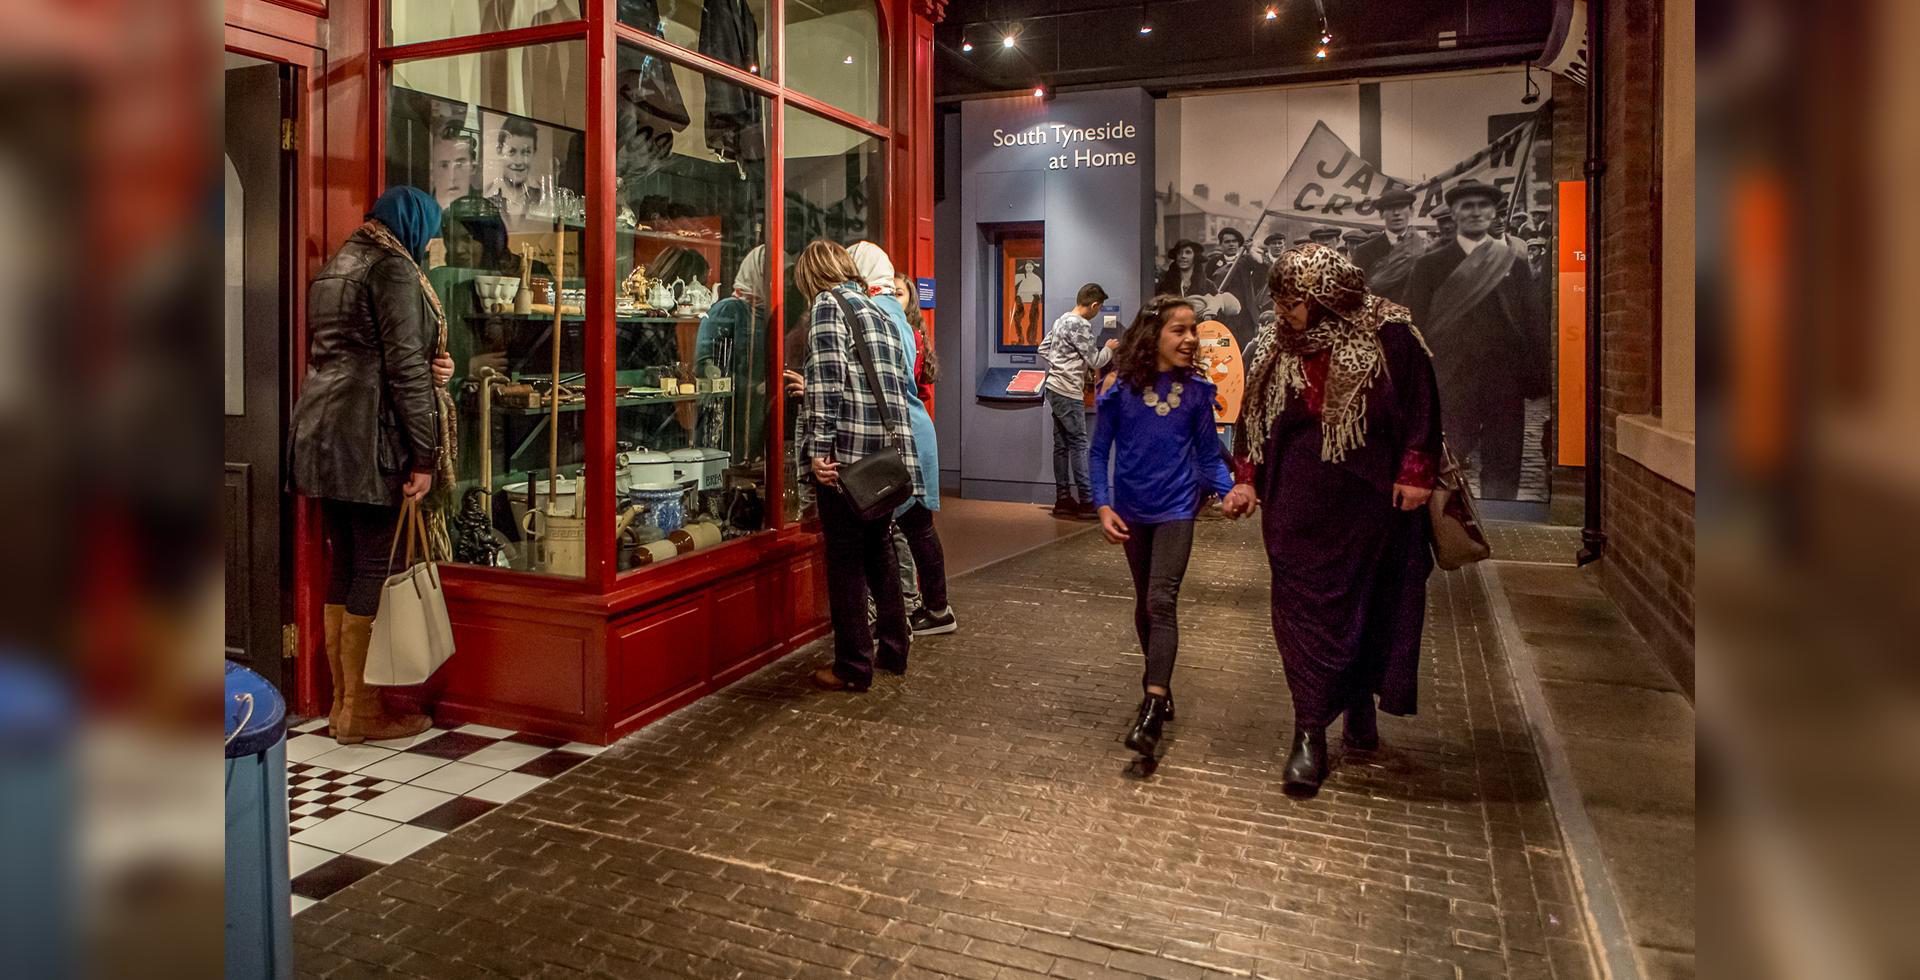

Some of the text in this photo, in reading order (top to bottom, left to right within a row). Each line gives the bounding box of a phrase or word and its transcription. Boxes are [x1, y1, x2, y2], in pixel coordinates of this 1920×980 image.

[993, 120, 1136, 148] South Tyneside
[1049, 148, 1136, 169] at Home
